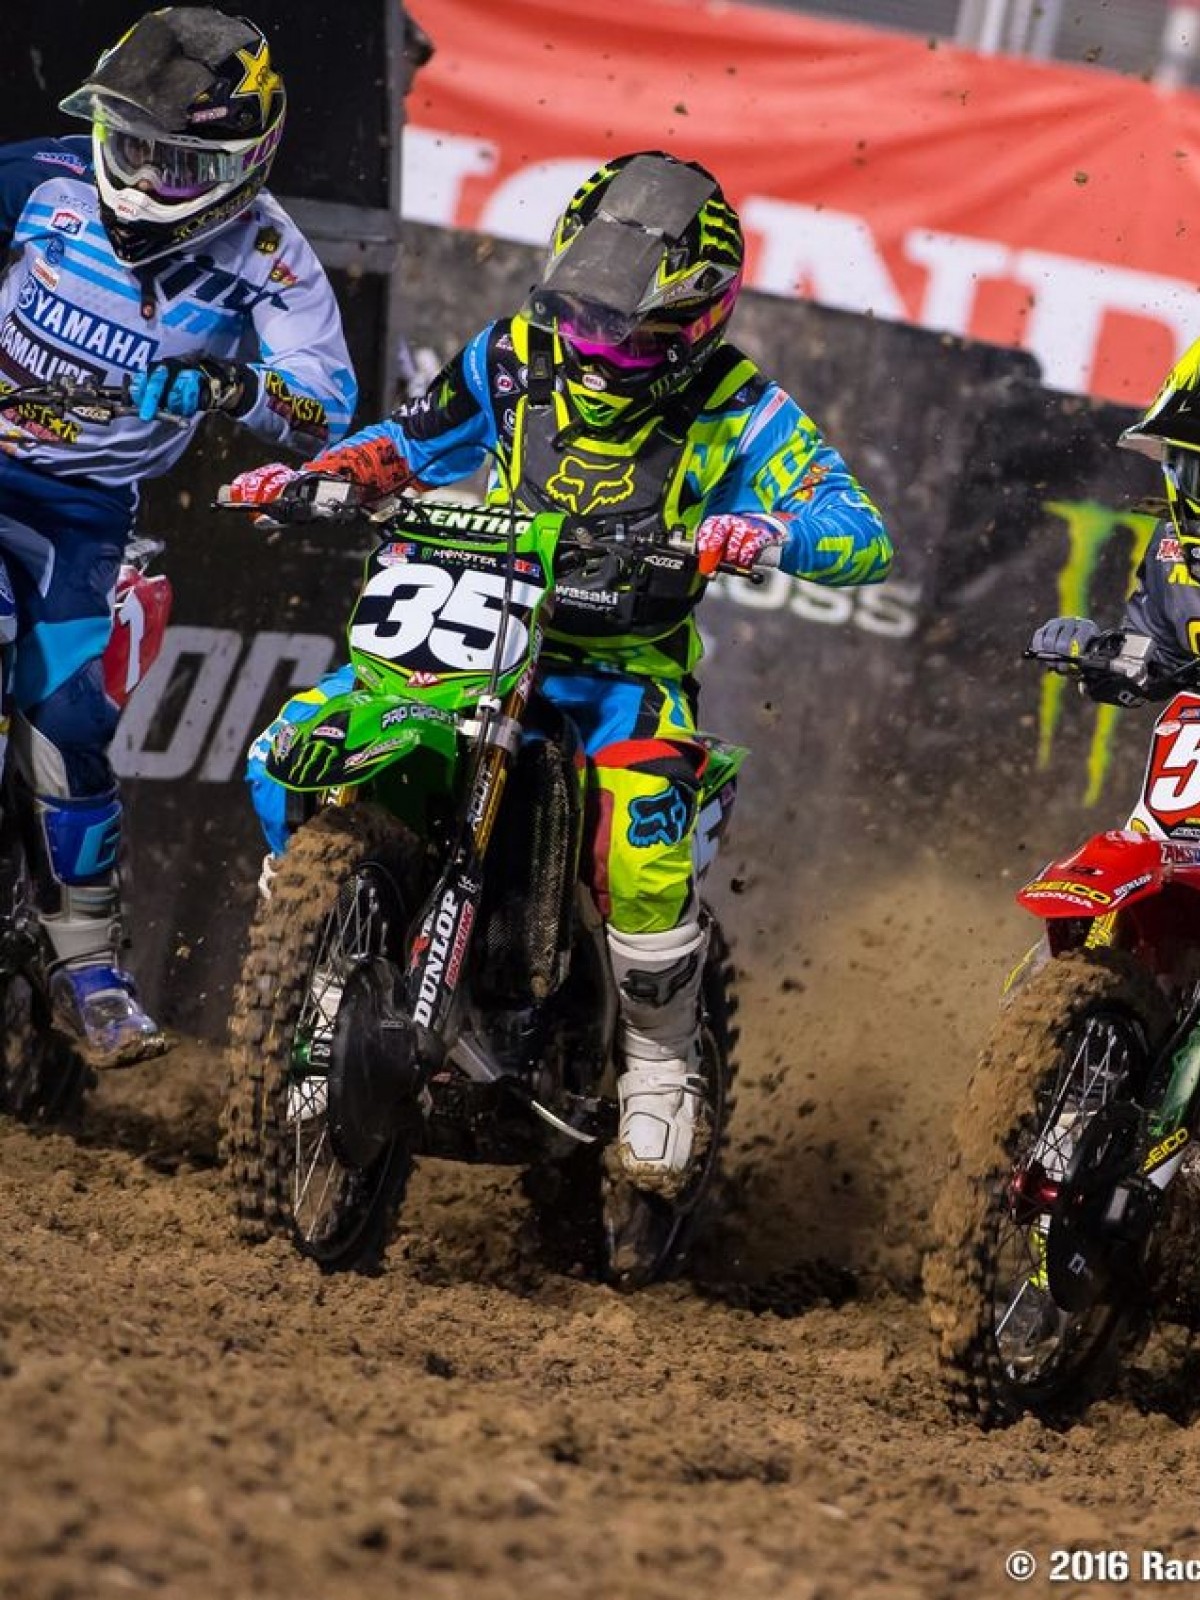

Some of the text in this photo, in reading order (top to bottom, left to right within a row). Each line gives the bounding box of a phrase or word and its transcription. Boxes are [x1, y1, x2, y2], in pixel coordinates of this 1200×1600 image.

[34, 288, 153, 373] YAMAHA
[350, 562, 545, 671] 35
[1025, 881, 1111, 905] GEICO
[413, 889, 459, 1029] DUNLOP
